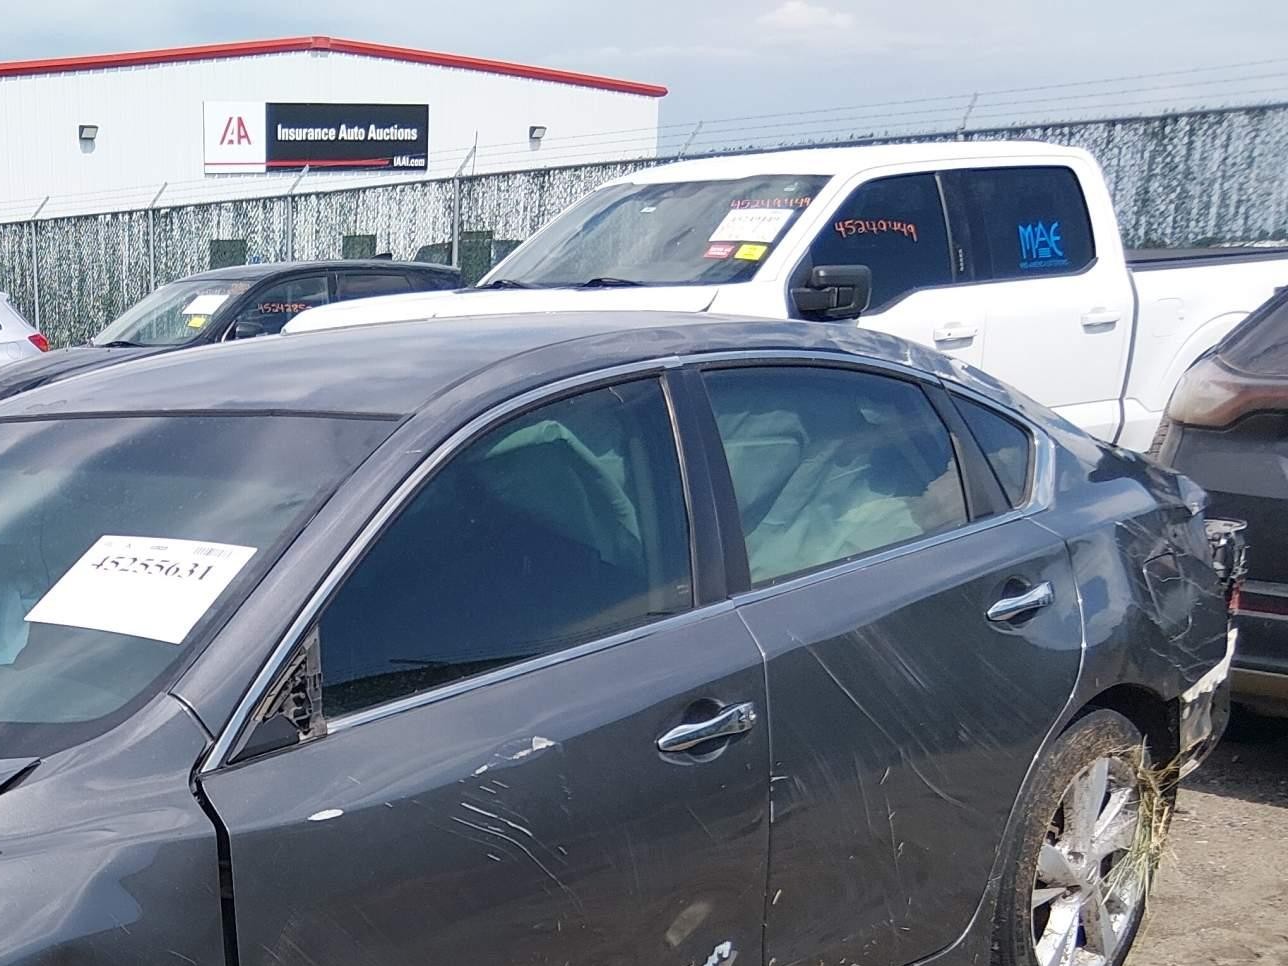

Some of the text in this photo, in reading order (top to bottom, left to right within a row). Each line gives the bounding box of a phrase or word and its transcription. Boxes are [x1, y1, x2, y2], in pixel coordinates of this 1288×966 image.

[277, 124, 418, 141] Insurance Auto Auctions
[257, 303, 314, 314] 4524285
[91, 556, 214, 580] 45255631
